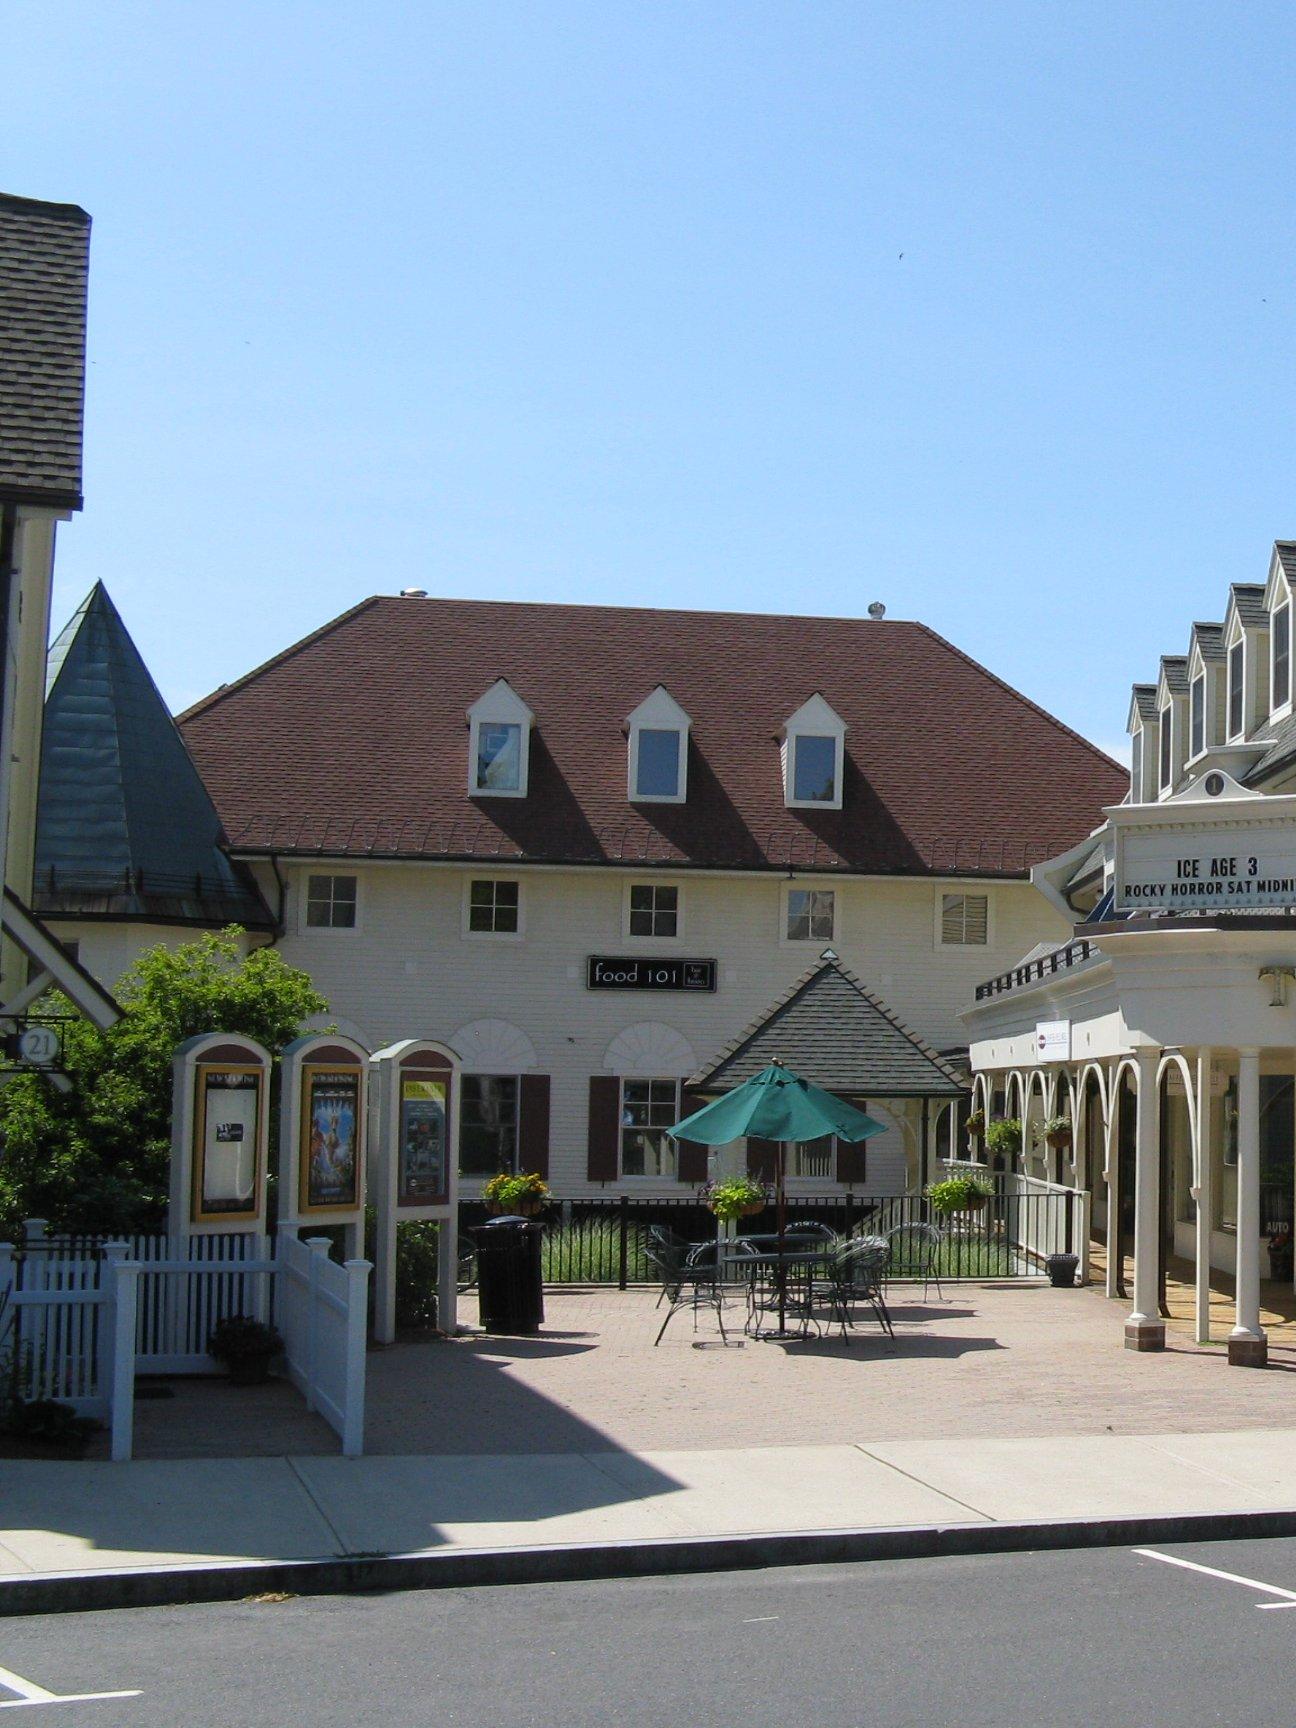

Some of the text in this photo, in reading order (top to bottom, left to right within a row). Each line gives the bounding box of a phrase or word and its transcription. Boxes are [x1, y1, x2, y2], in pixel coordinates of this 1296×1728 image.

[1177, 857, 1258, 878] ICE AGE 3
[1124, 883, 1168, 898] ROCKY
[1171, 881, 1223, 896] HORROR
[1228, 880, 1252, 894] SAT
[595, 962, 638, 982] food
[647, 969, 677, 983] 101
[29, 1034, 50, 1055] 21
[1265, 1221, 1289, 1234] AUTO
